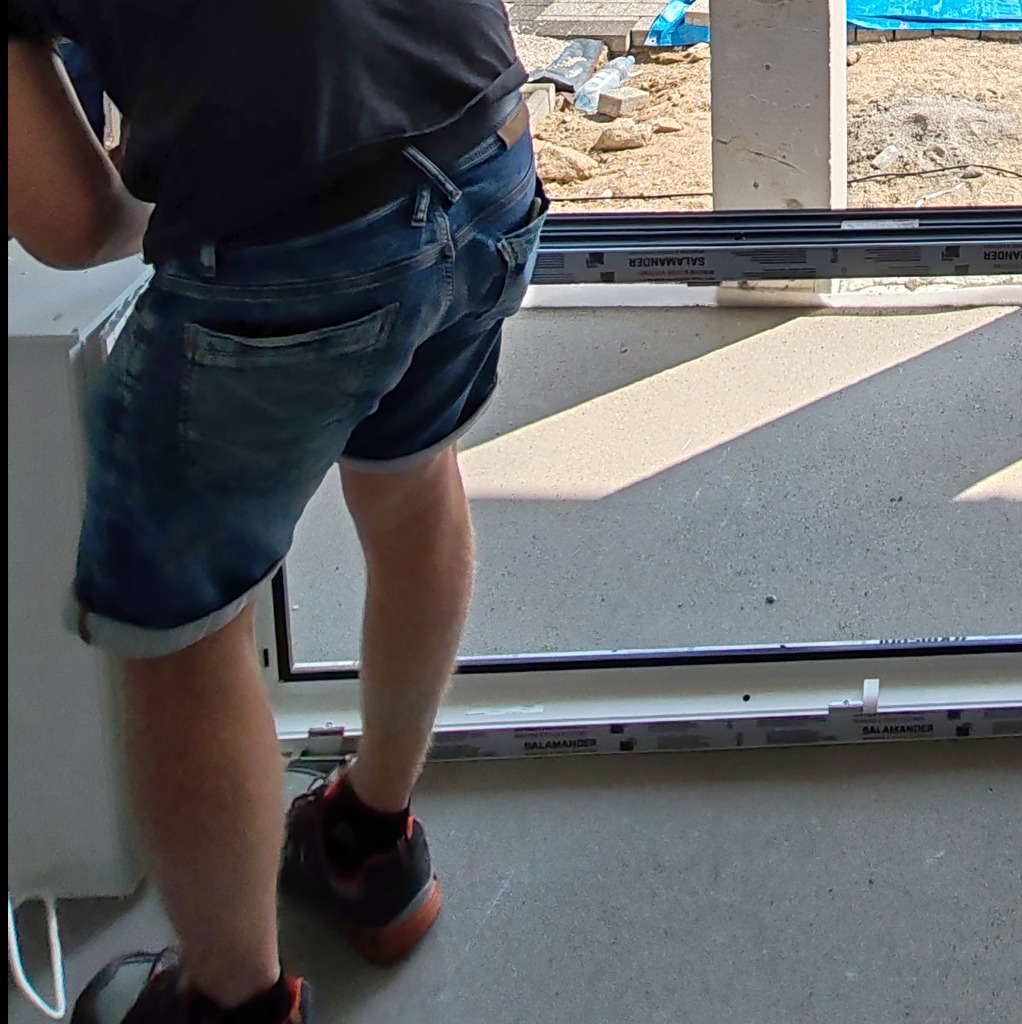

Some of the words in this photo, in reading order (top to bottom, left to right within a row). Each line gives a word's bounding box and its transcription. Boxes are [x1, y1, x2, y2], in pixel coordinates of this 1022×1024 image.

[629, 257, 705, 267] SALAMANDER
[862, 724, 933, 735] SALAMANDER
[524, 738, 597, 750] SALAMANDER
